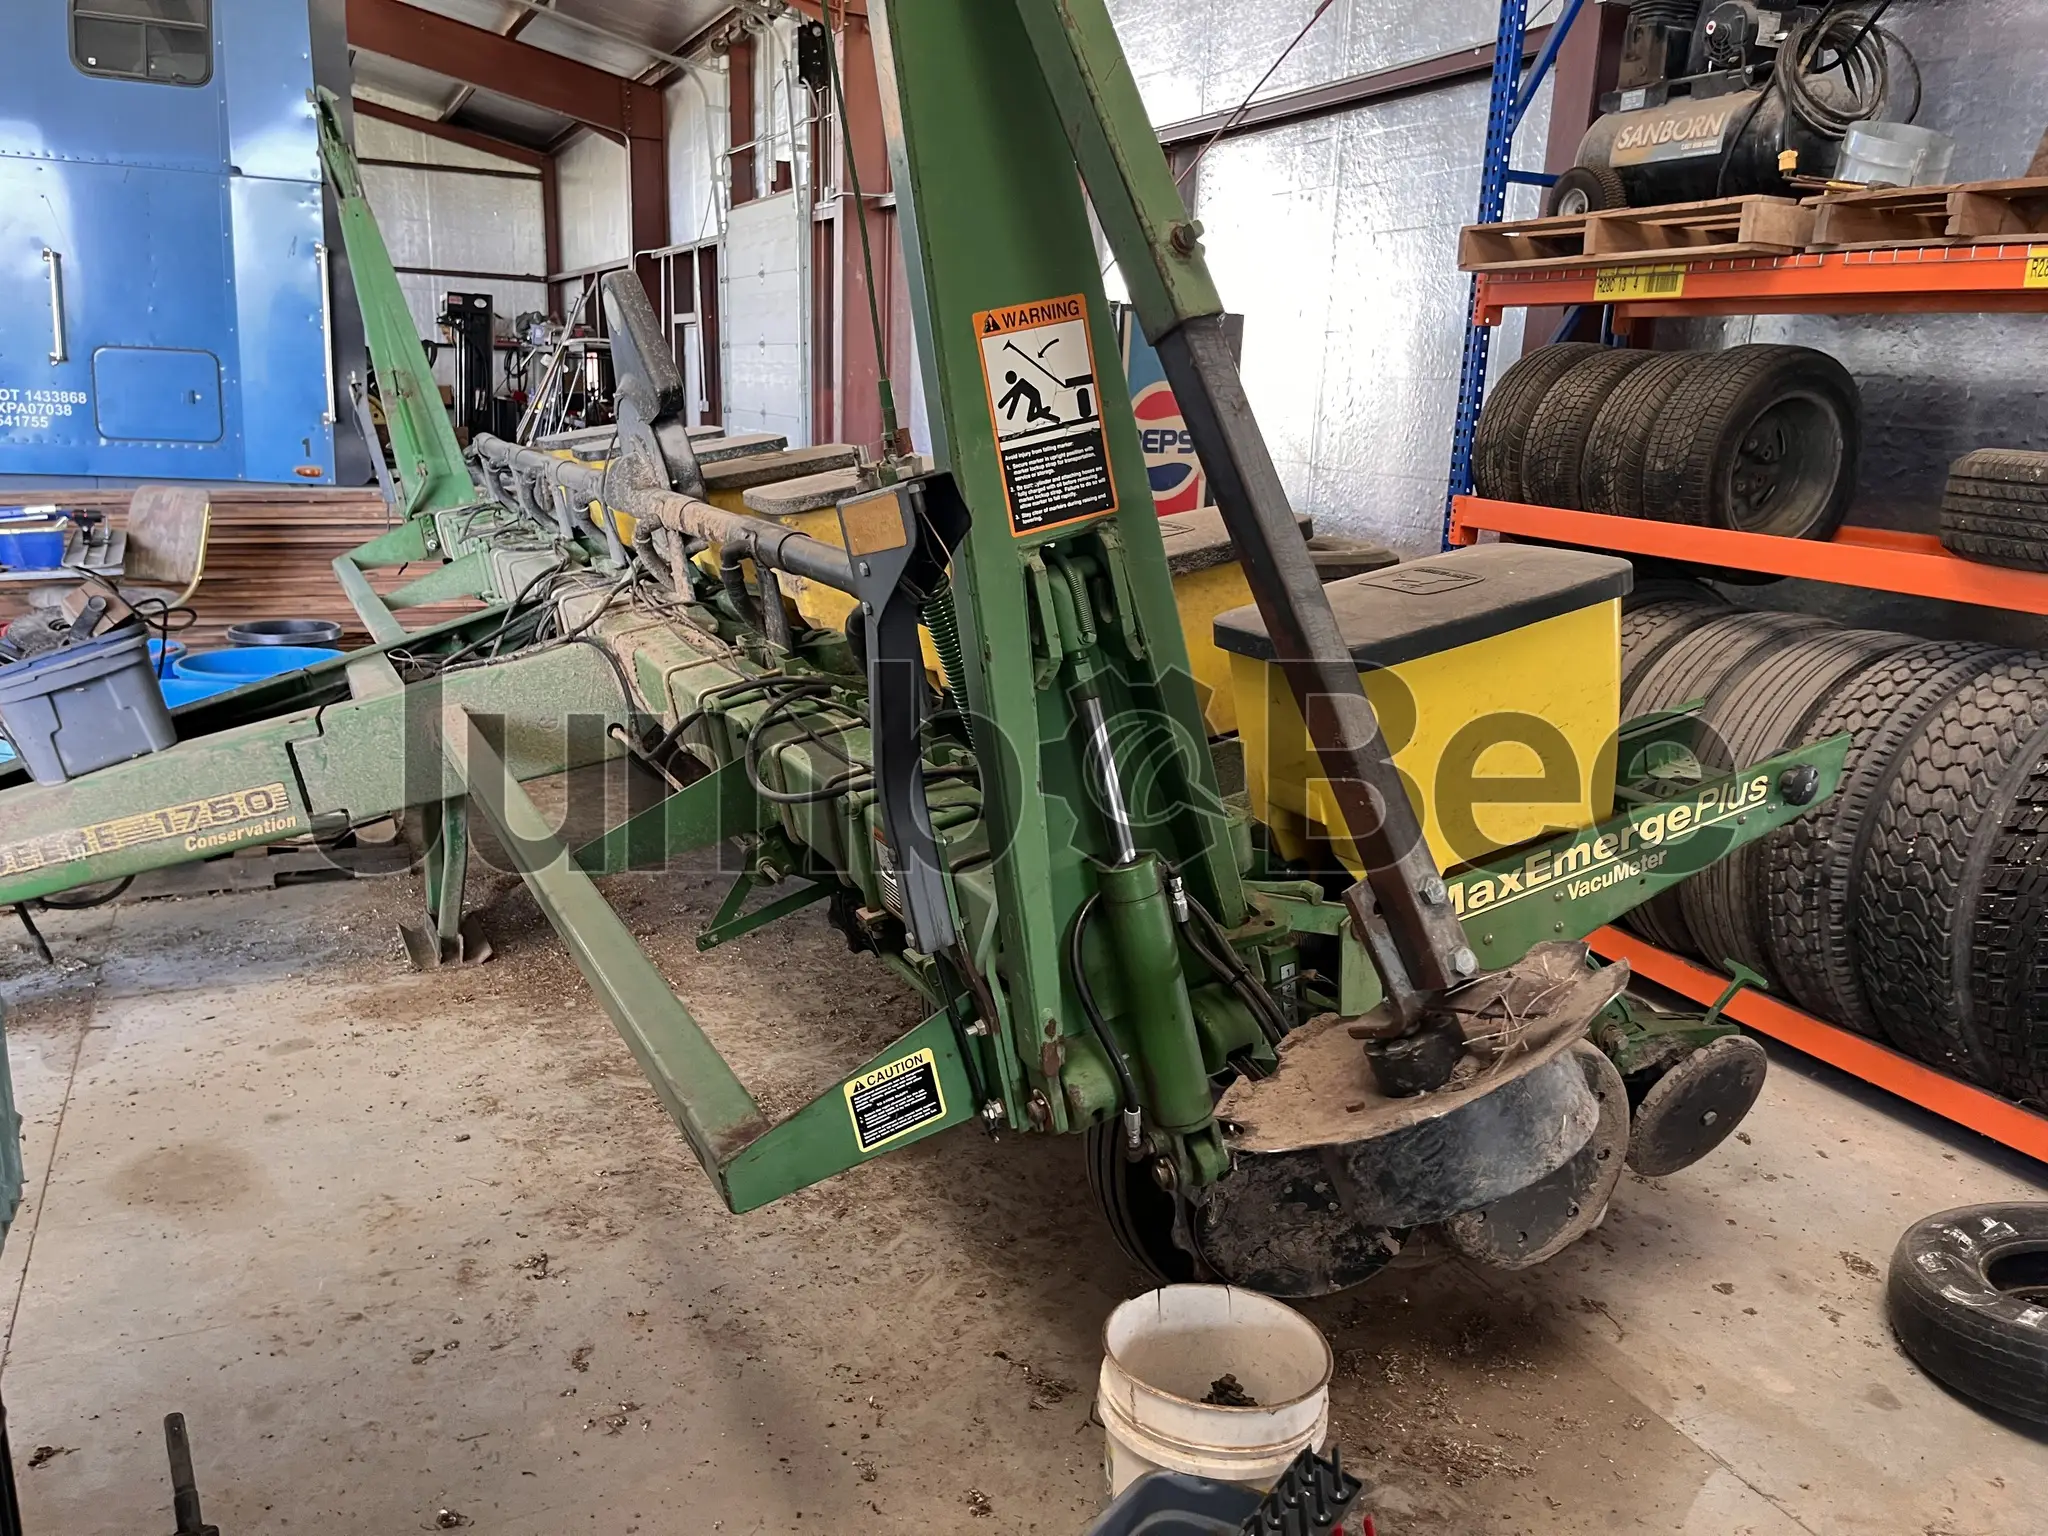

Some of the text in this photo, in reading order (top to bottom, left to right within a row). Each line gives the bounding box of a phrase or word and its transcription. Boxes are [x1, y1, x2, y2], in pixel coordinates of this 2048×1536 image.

[1617, 112, 1726, 150] SANBORN
[1001, 300, 1079, 328] WARNING
[25, 389, 87, 404] 1433868
[302, 438, 310, 457] 1
[1138, 429, 1195, 454] EPS
[154, 789, 274, 834] 1750
[184, 815, 297, 852] Conservation
[1567, 850, 1668, 901] VacuMeter
[867, 1054, 924, 1086] CAUTION
